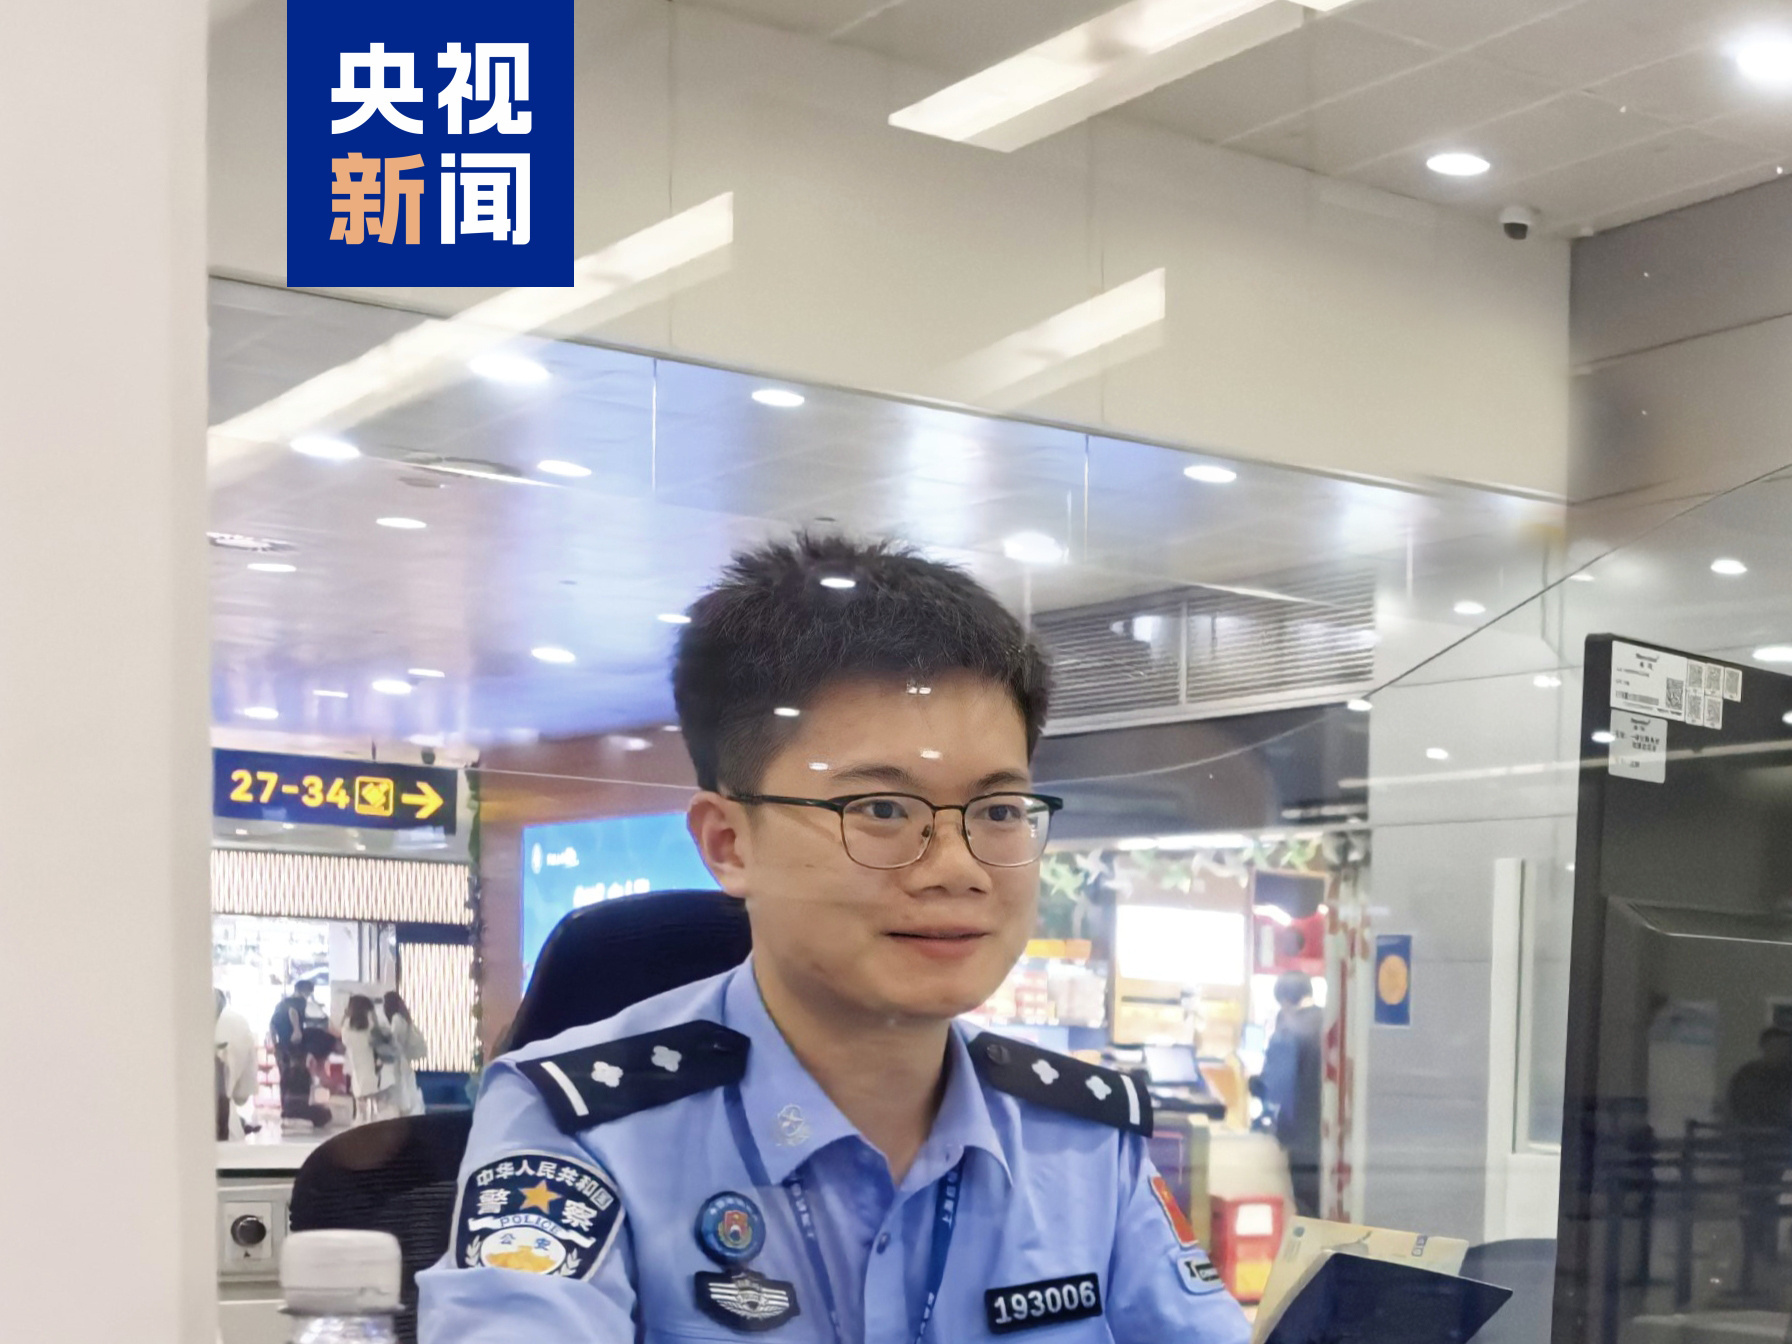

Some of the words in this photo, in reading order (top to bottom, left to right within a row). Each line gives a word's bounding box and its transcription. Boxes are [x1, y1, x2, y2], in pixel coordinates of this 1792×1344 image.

[229, 768, 351, 810] 27-34
[475, 1159, 615, 1212] 中华人民共和国
[500, 1214, 562, 1236] POLICE
[993, 1280, 1097, 1325] 193006
